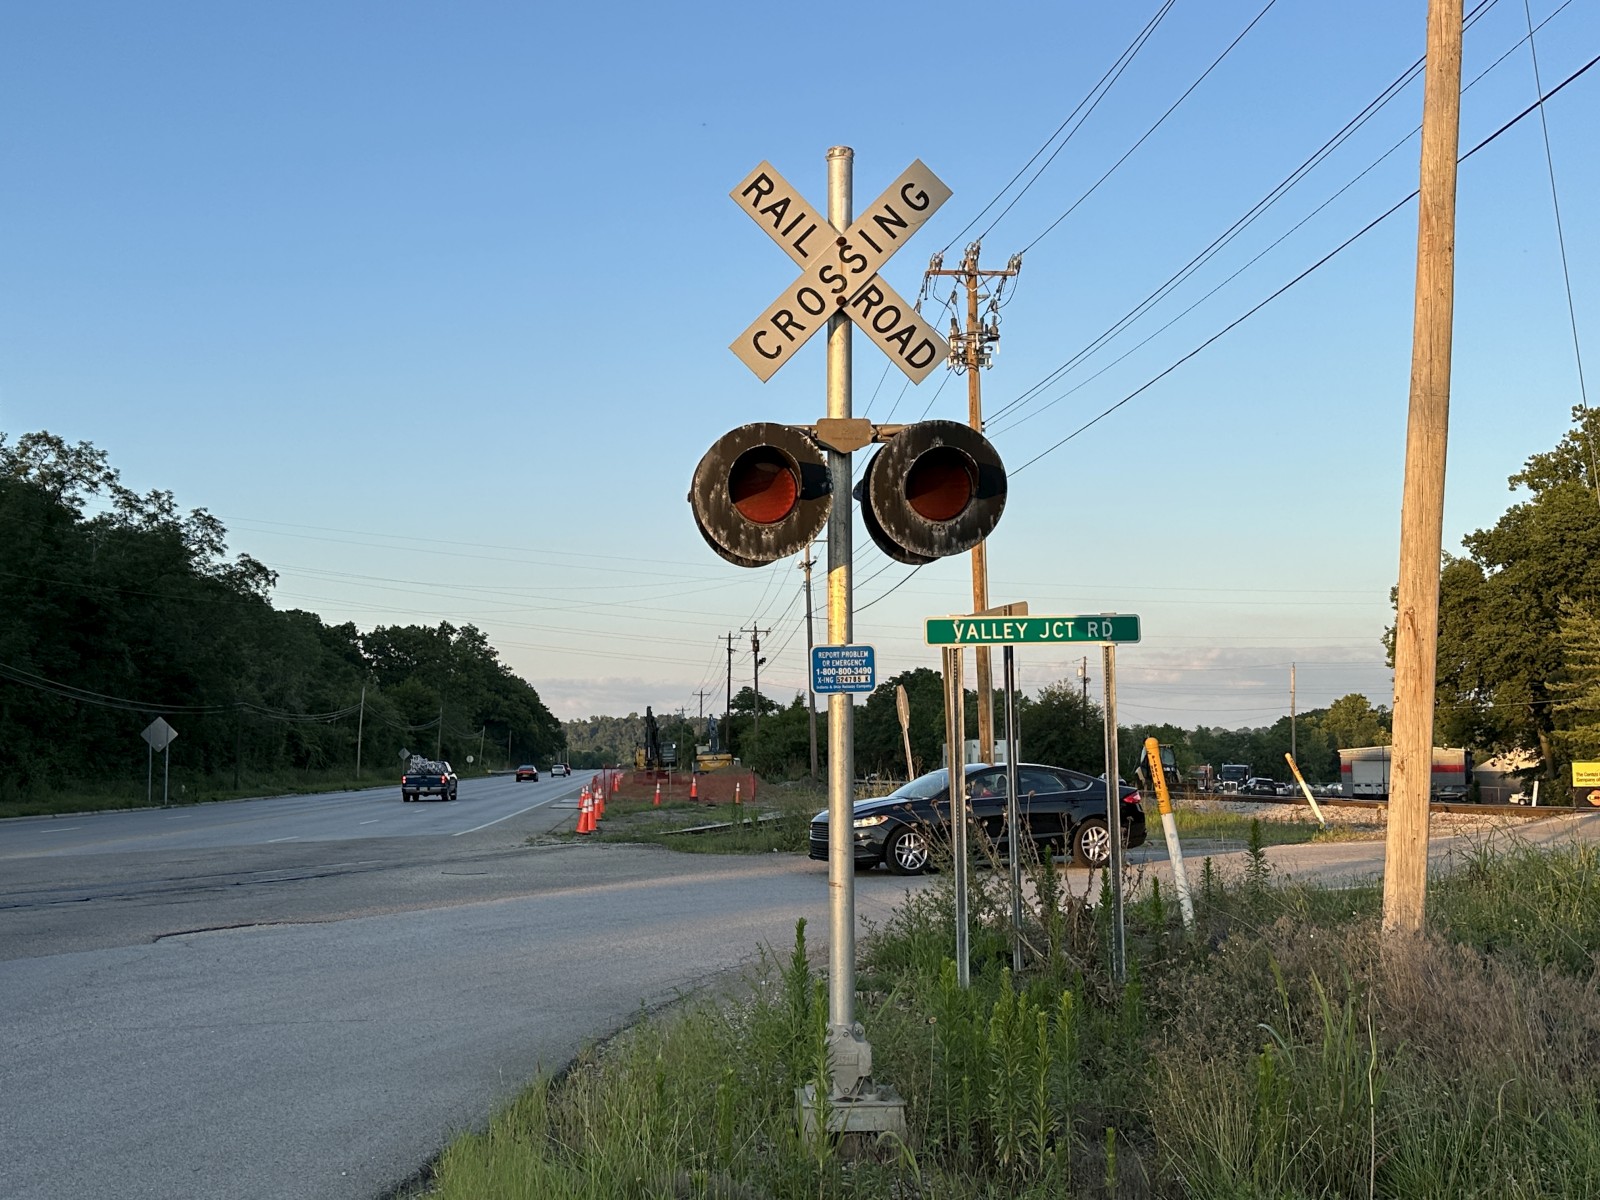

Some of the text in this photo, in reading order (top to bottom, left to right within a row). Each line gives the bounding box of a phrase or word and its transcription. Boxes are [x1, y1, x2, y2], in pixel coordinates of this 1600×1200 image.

[741, 172, 818, 258] RAIL
[752, 182, 930, 360] CROSSING
[851, 283, 937, 369] ROAD
[816, 667, 872, 675] 1-800-800-3490
[952, 621, 1113, 640] VALLEY JCT RD
